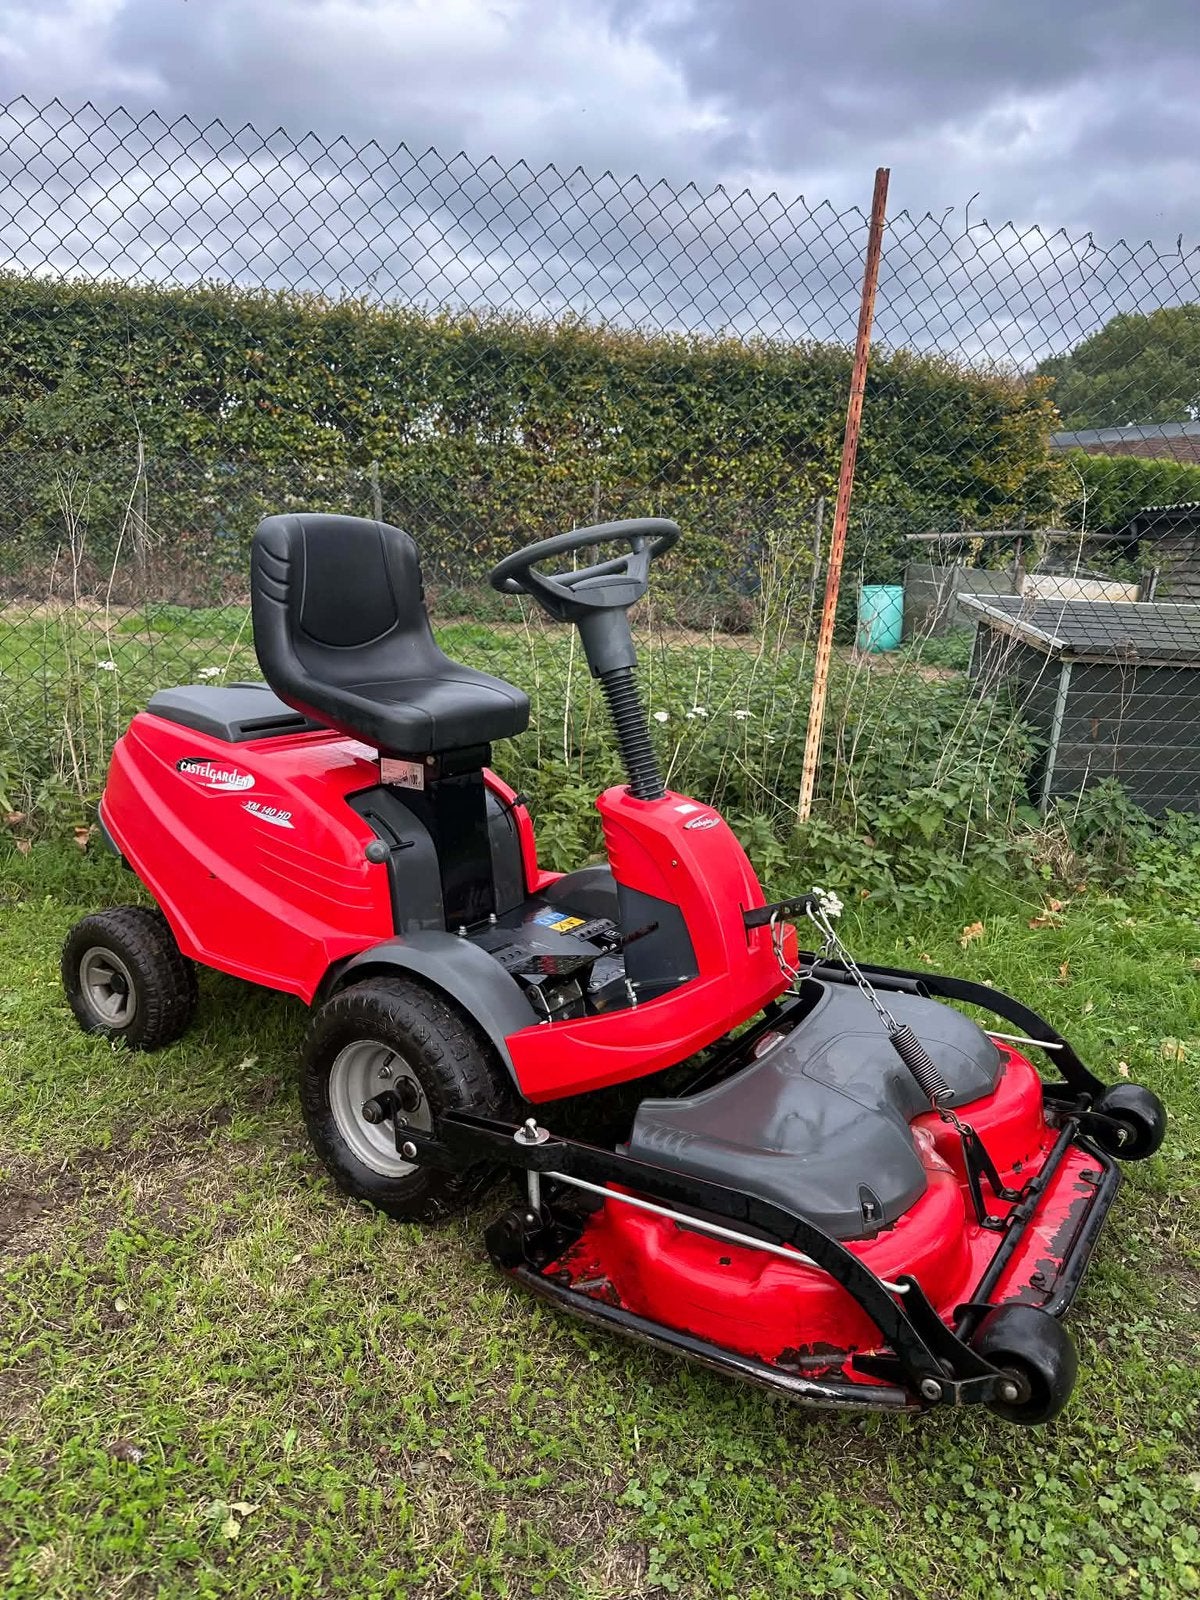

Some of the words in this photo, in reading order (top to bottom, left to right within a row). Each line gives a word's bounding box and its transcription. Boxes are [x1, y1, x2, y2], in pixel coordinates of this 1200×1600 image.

[245, 800, 261, 812] XM
[261, 806, 276, 816] 140
[277, 811, 292, 821] HD
